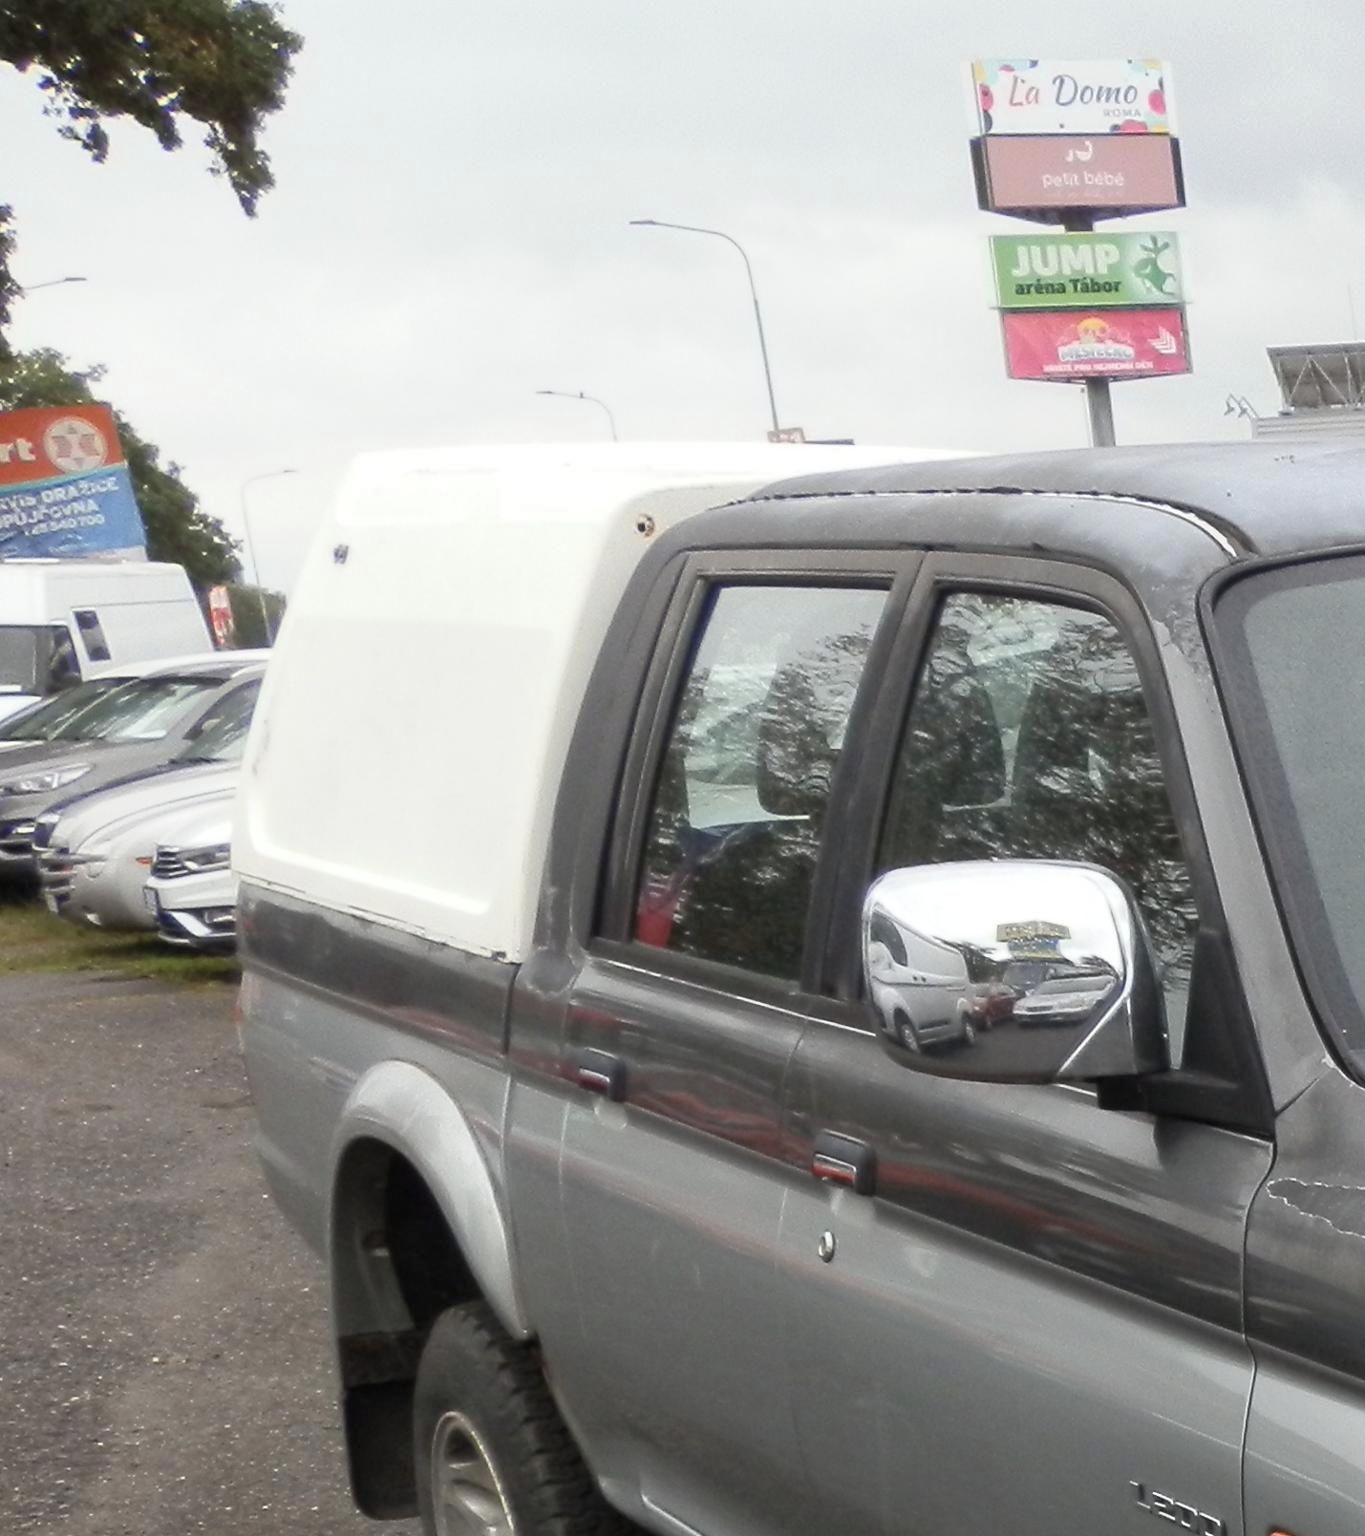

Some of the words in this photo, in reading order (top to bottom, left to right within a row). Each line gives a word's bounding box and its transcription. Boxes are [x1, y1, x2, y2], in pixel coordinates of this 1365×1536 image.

[1008, 75, 1040, 107] La
[1052, 74, 1138, 106] Domo
[1103, 108, 1141, 118] ROMA
[1041, 171, 1080, 189] petit
[1083, 170, 1125, 187] bébé
[1011, 243, 1120, 278] JUMP
[1014, 277, 1066, 296] aréna
[1069, 276, 1123, 294] Tábor
